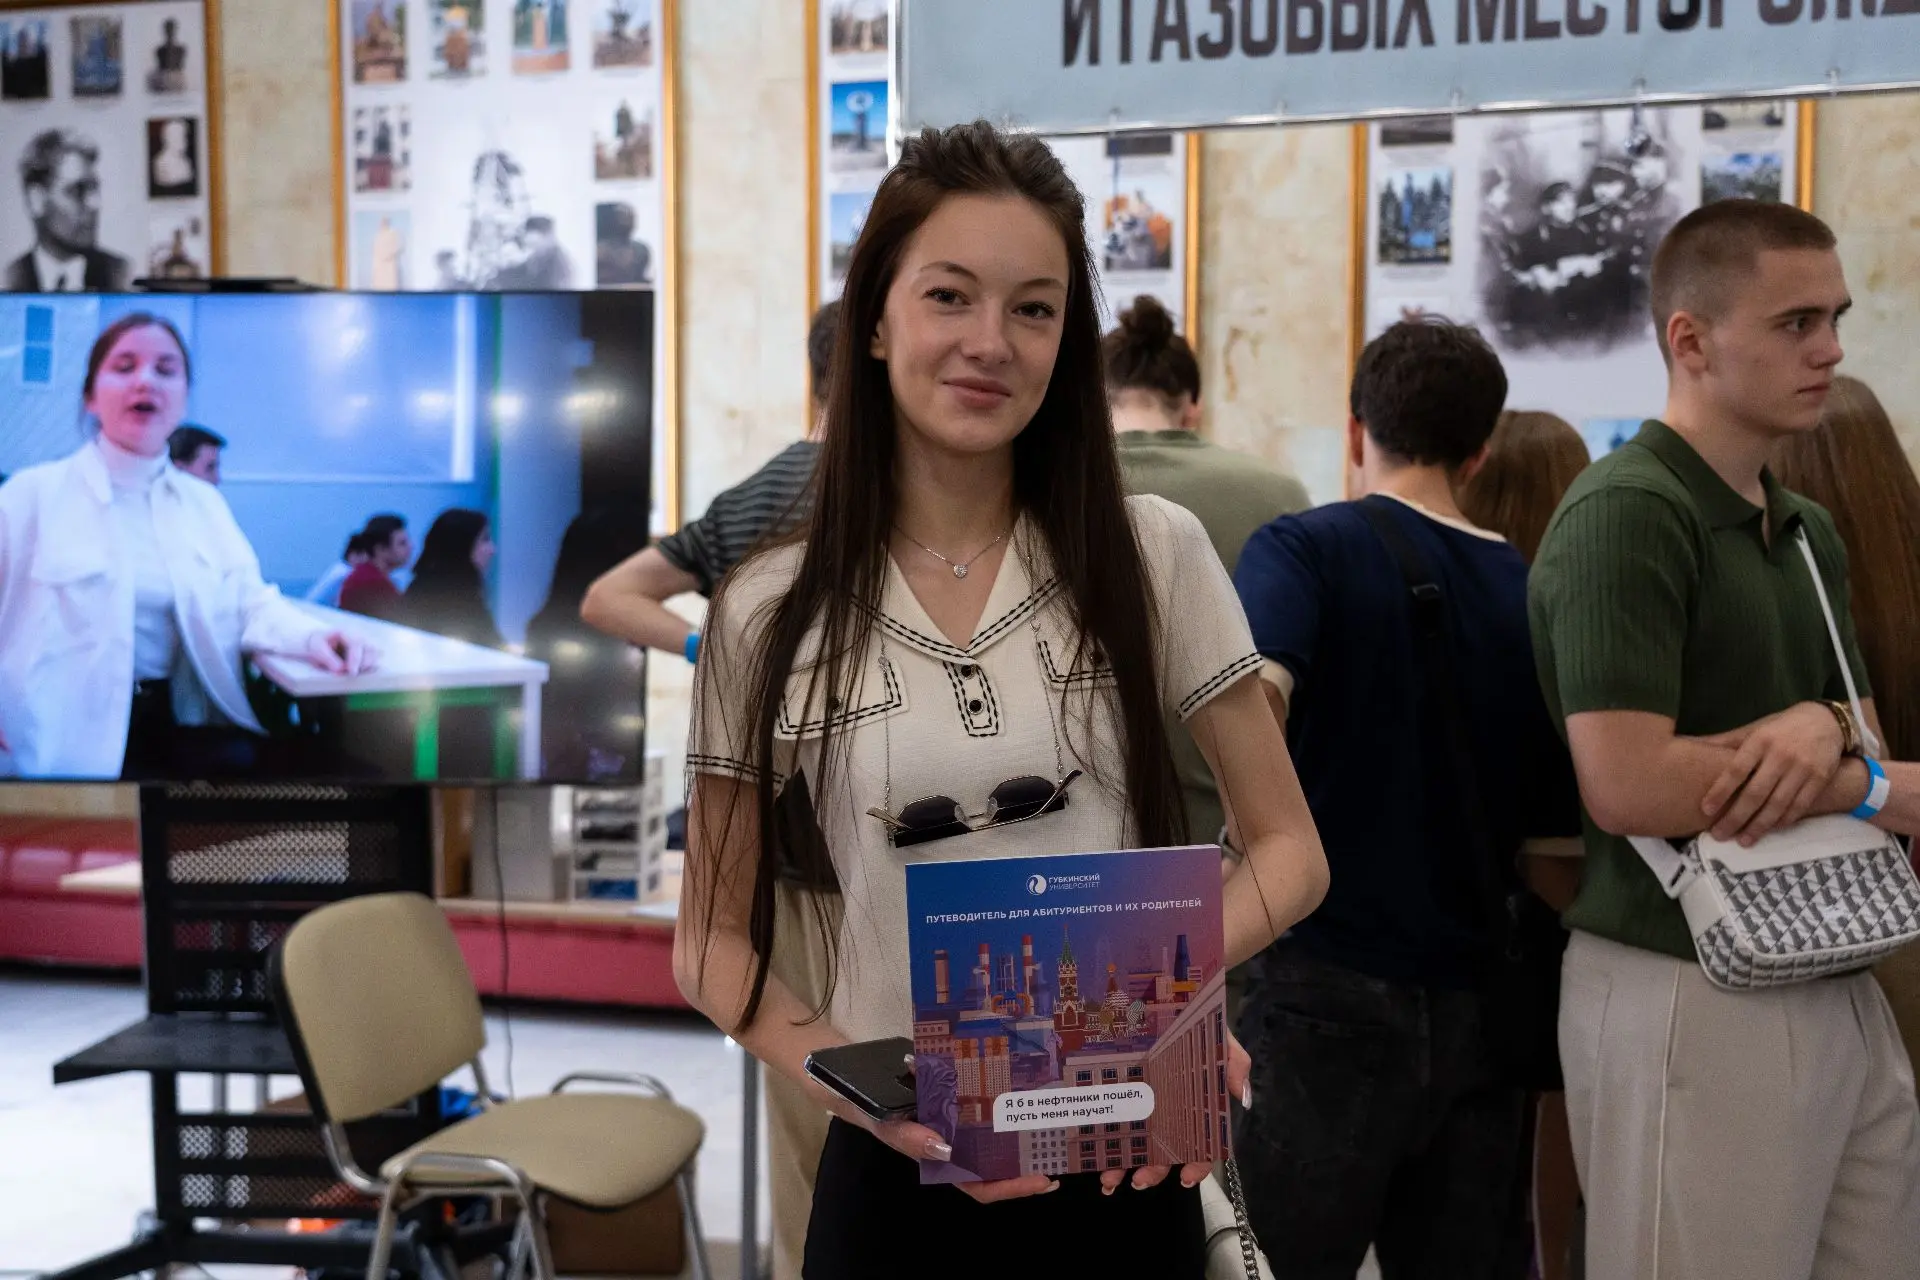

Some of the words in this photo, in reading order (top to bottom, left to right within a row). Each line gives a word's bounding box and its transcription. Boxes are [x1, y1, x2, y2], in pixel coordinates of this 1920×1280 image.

[1048, 873, 1101, 883] ГУБКИНСКИЙ
[1048, 881, 1101, 891] УНИВЕРСИТЕТ
[926, 911, 1007, 924] ПУТЕВОДИТЕЛЬ
[1008, 909, 1030, 920] ДЛЯ
[1032, 904, 1113, 917] АБИТУРИЕНТОВ
[1115, 903, 1122, 912] И
[1125, 902, 1139, 911] ИХ
[1141, 897, 1202, 910] РОДИТЕЛЕЙ
[1005, 1099, 1013, 1109] Я
[1017, 1098, 1024, 1108] б
[1027, 1099, 1034, 1107] в
[1037, 1093, 1100, 1107] нефтяники
[1103, 1090, 1143, 1101] пошёл,
[1006, 1112, 1038, 1123] пусть
[1041, 1109, 1069, 1119] меня
[1072, 1104, 1114, 1117] научат!
